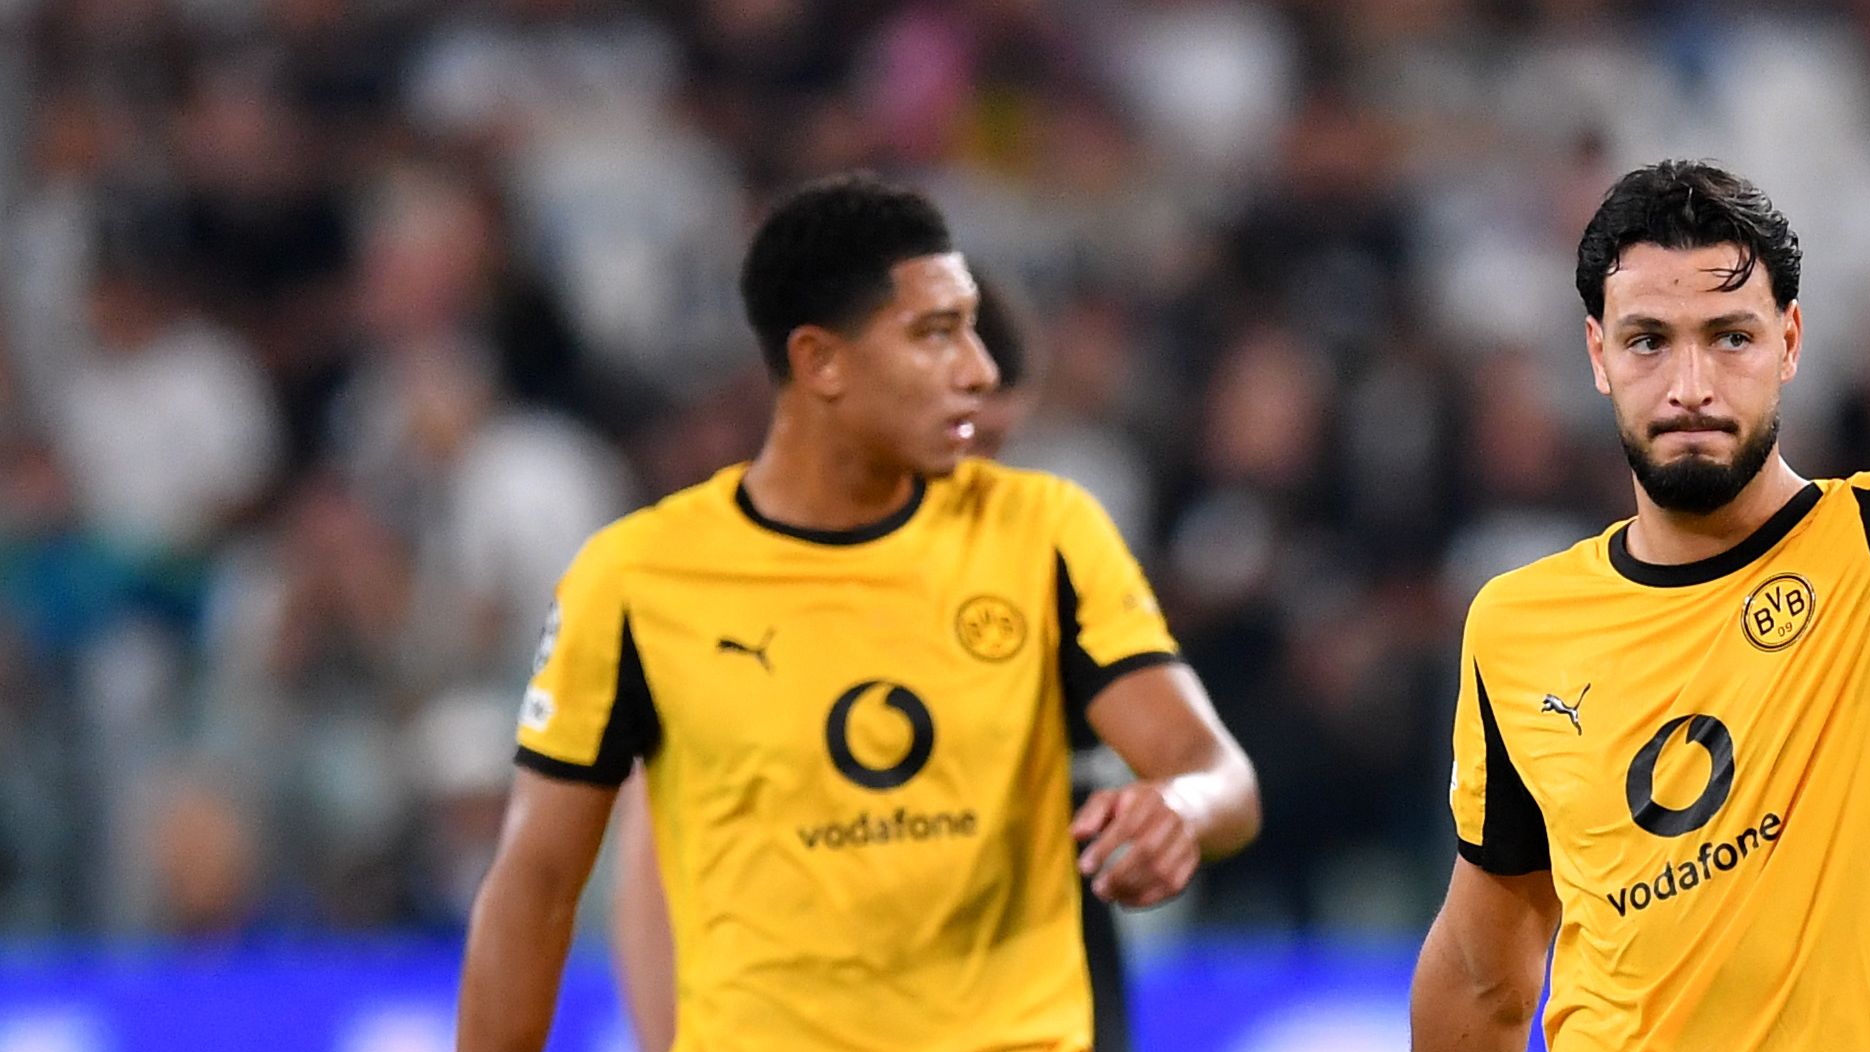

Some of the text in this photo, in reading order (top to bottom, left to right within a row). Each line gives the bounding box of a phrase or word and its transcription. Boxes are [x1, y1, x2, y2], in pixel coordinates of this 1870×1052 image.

[1753, 586, 1805, 636] BVB
[1777, 621, 1793, 637] 09
[796, 807, 977, 849] vodafone
[1607, 813, 1782, 917] vodafone
